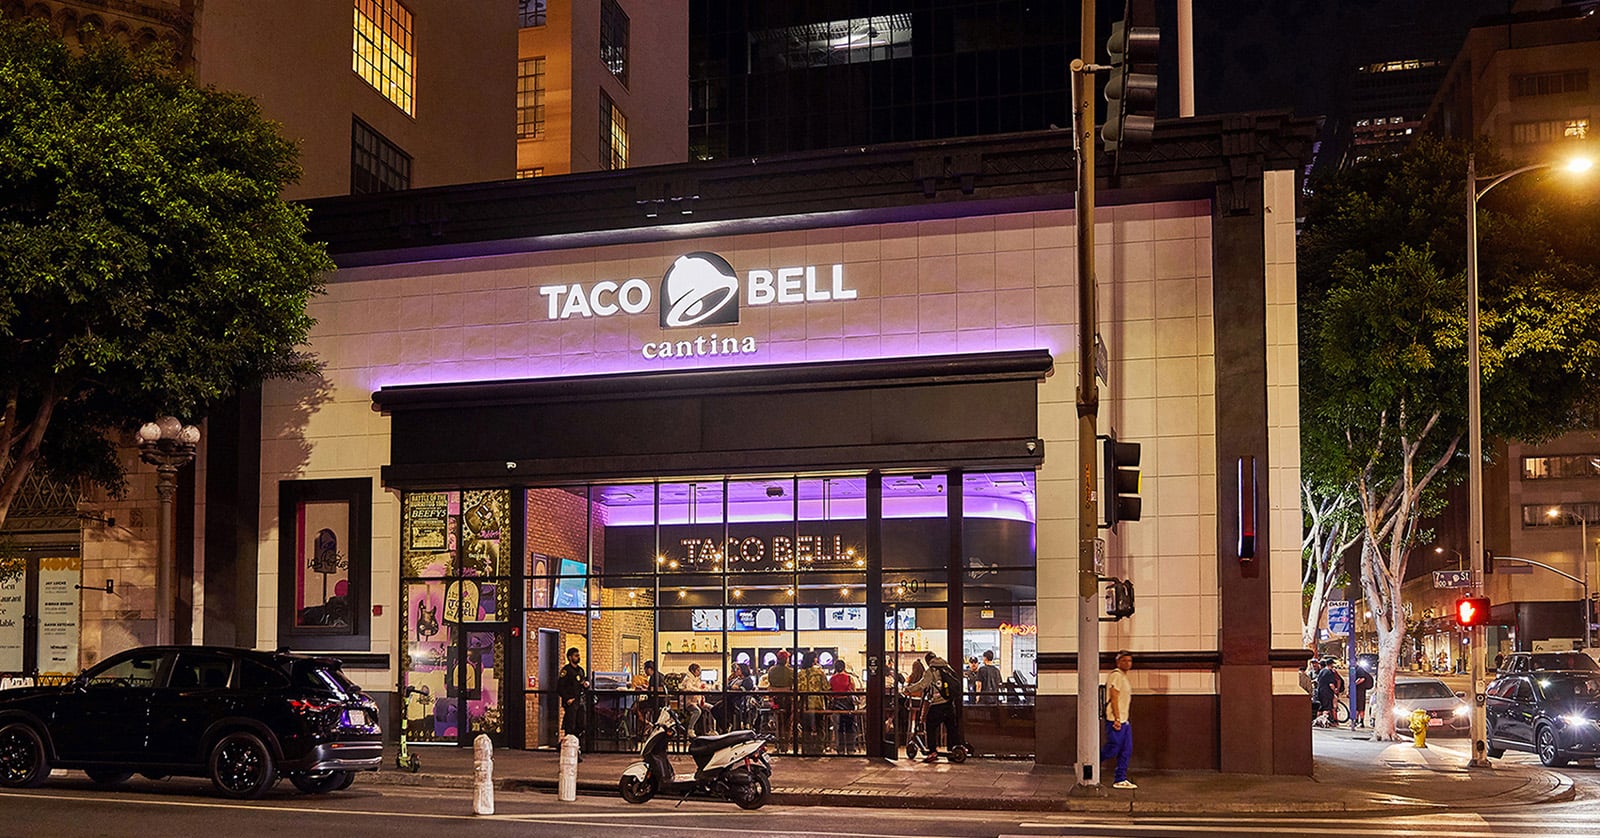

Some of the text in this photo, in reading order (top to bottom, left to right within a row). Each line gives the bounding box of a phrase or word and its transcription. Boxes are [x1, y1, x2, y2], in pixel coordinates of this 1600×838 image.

[539, 263, 858, 320] TACO BELL
[641, 333, 757, 359] cantina
[680, 533, 851, 564] TACO BELL
[900, 578, 928, 594] 801
[1460, 571, 1469, 581] St
